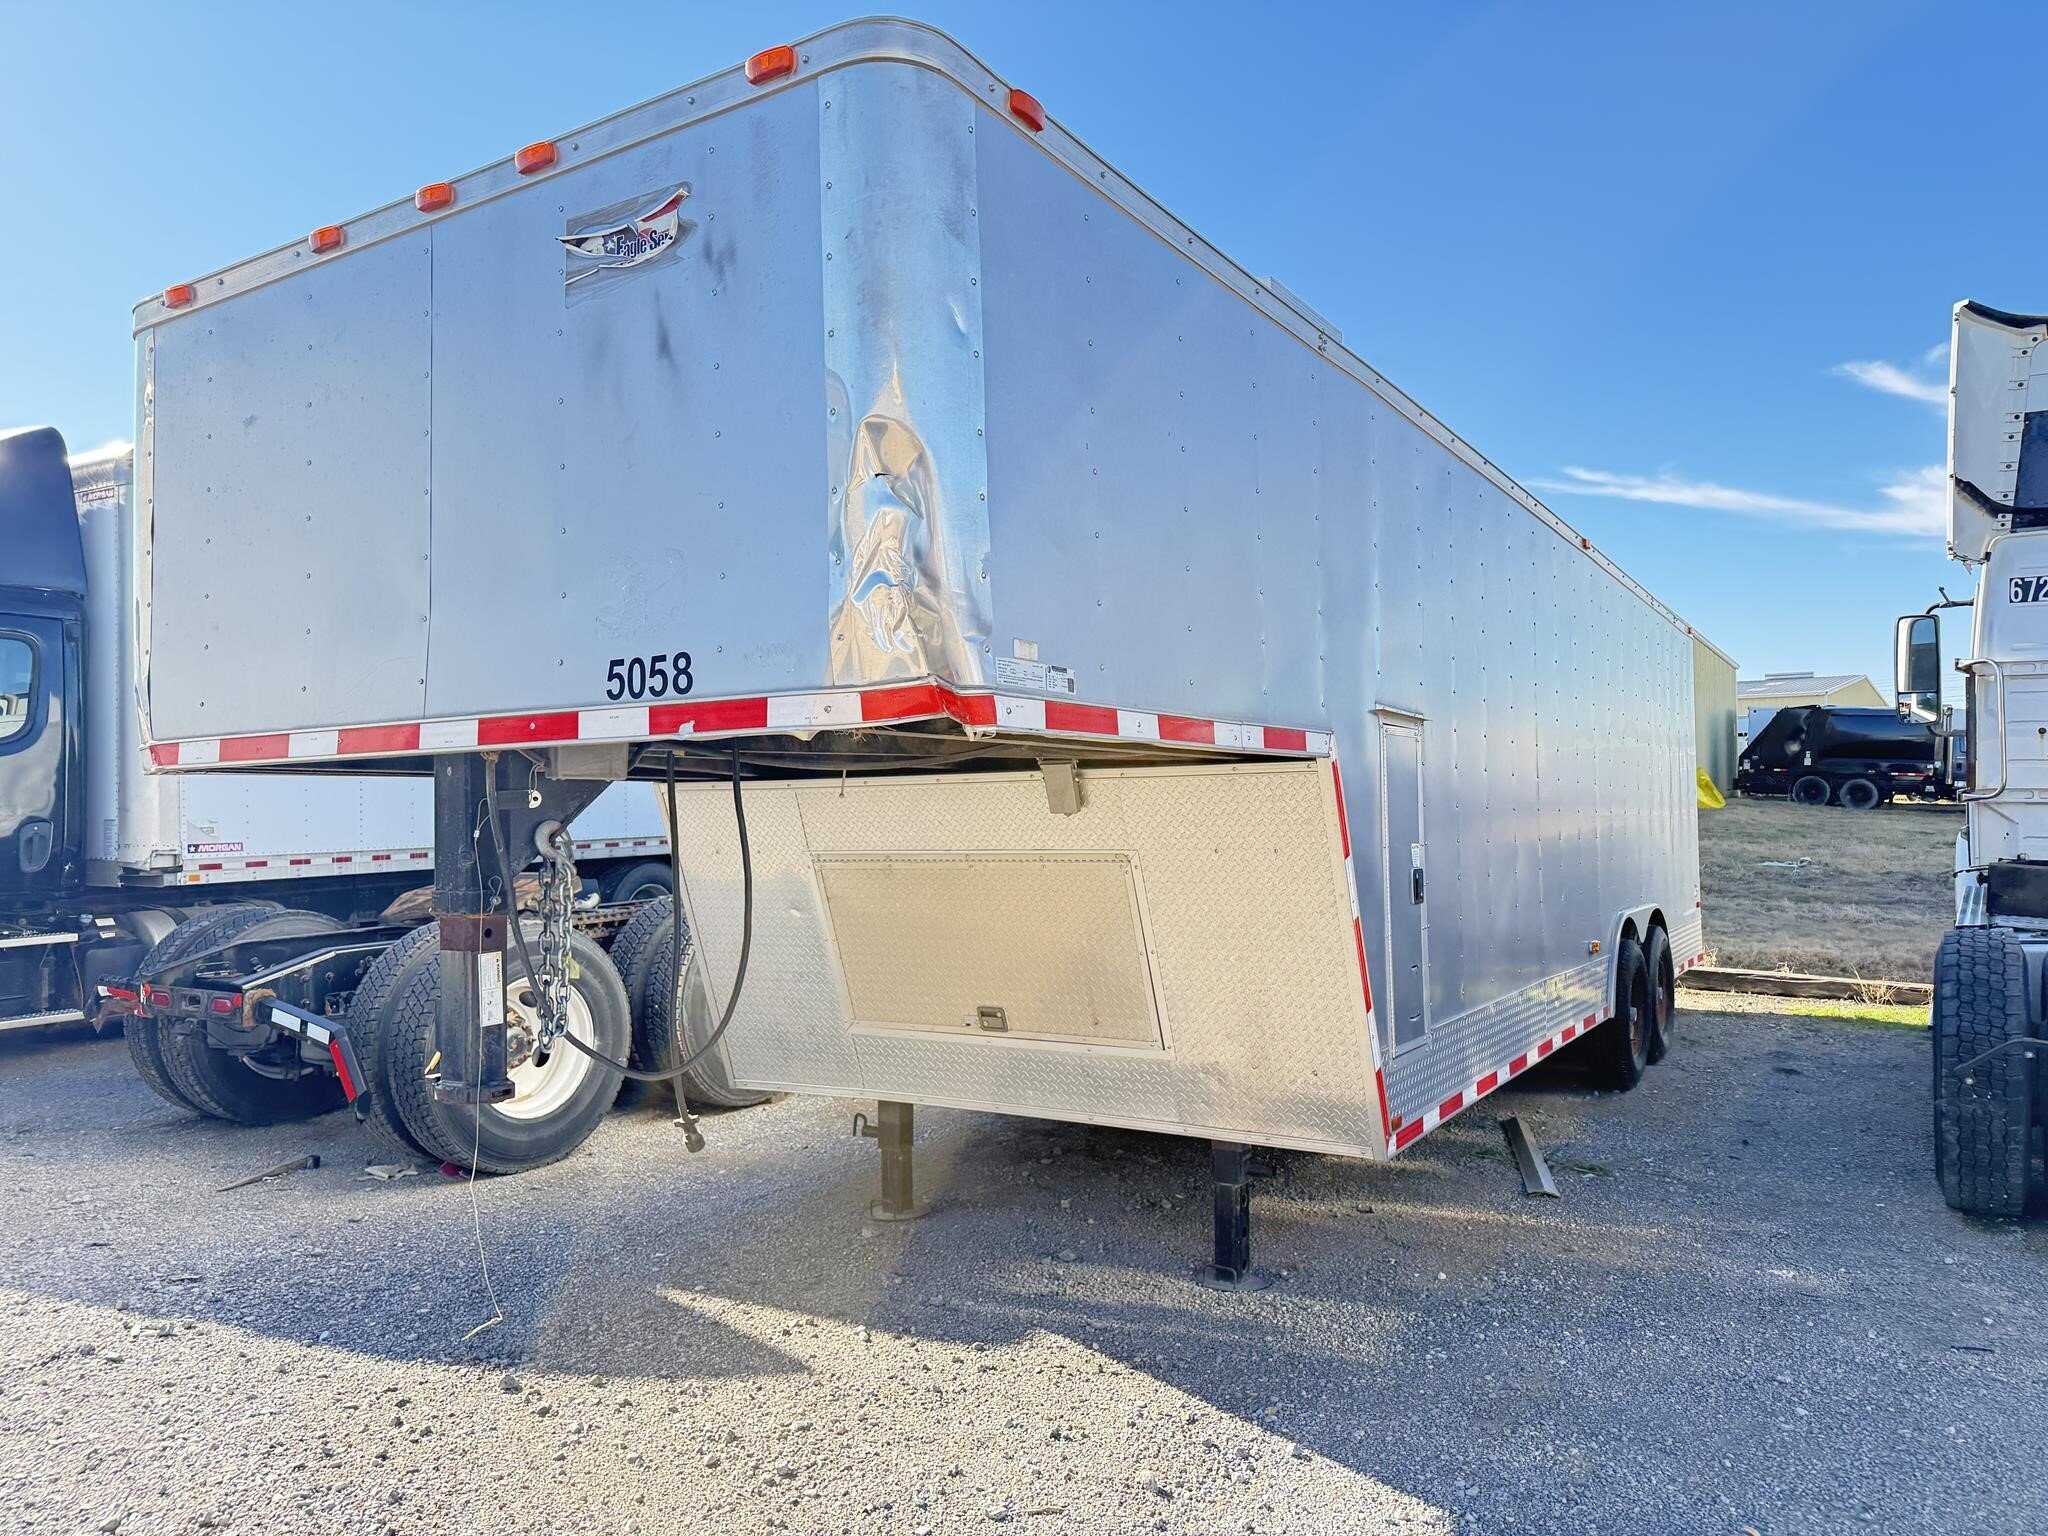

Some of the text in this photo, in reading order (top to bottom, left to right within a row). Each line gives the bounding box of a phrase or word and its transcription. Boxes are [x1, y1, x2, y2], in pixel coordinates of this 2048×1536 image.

[615, 233, 647, 258] Eagle
[606, 651, 694, 701] 5058
[197, 842, 242, 853] MORGAN
